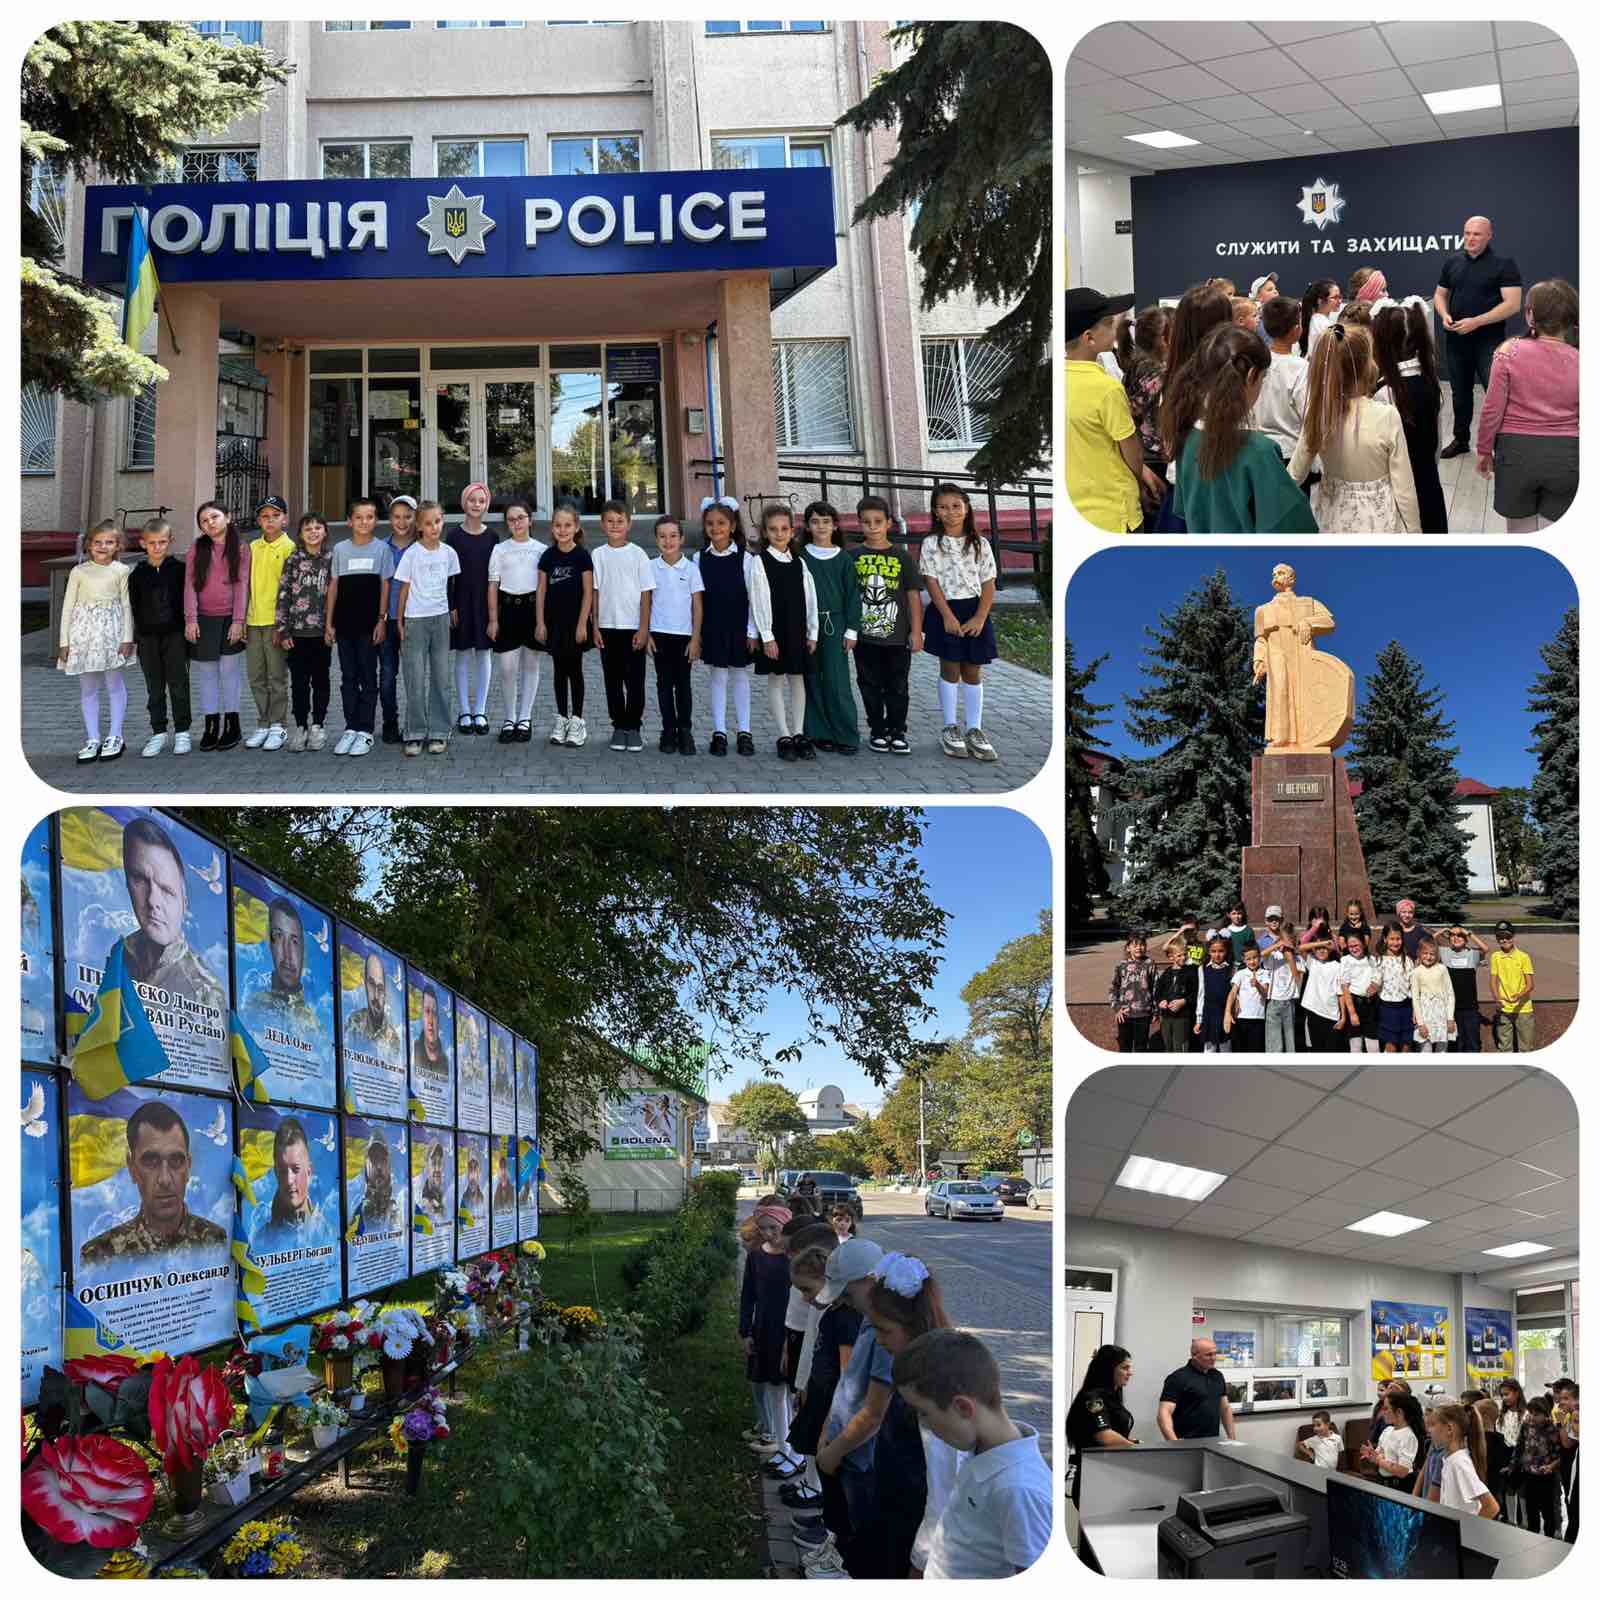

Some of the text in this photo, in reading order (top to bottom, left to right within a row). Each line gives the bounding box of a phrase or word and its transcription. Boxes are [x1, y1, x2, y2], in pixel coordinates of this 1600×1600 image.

[101, 201, 388, 258] ПОЛІЦІЯ
[525, 191, 768, 249] POLICE
[1215, 241, 1300, 256] СЛУЖИТИ
[1310, 239, 1335, 253] ТА
[856, 554, 900, 566] STAR
[856, 564, 902, 577] WARS
[174, 992, 220, 1019] Дмитро
[179, 1014, 226, 1041] Руслан)
[79, 1274, 163, 1304] ОСИПЧУК
[167, 1264, 230, 1287] Олександр
